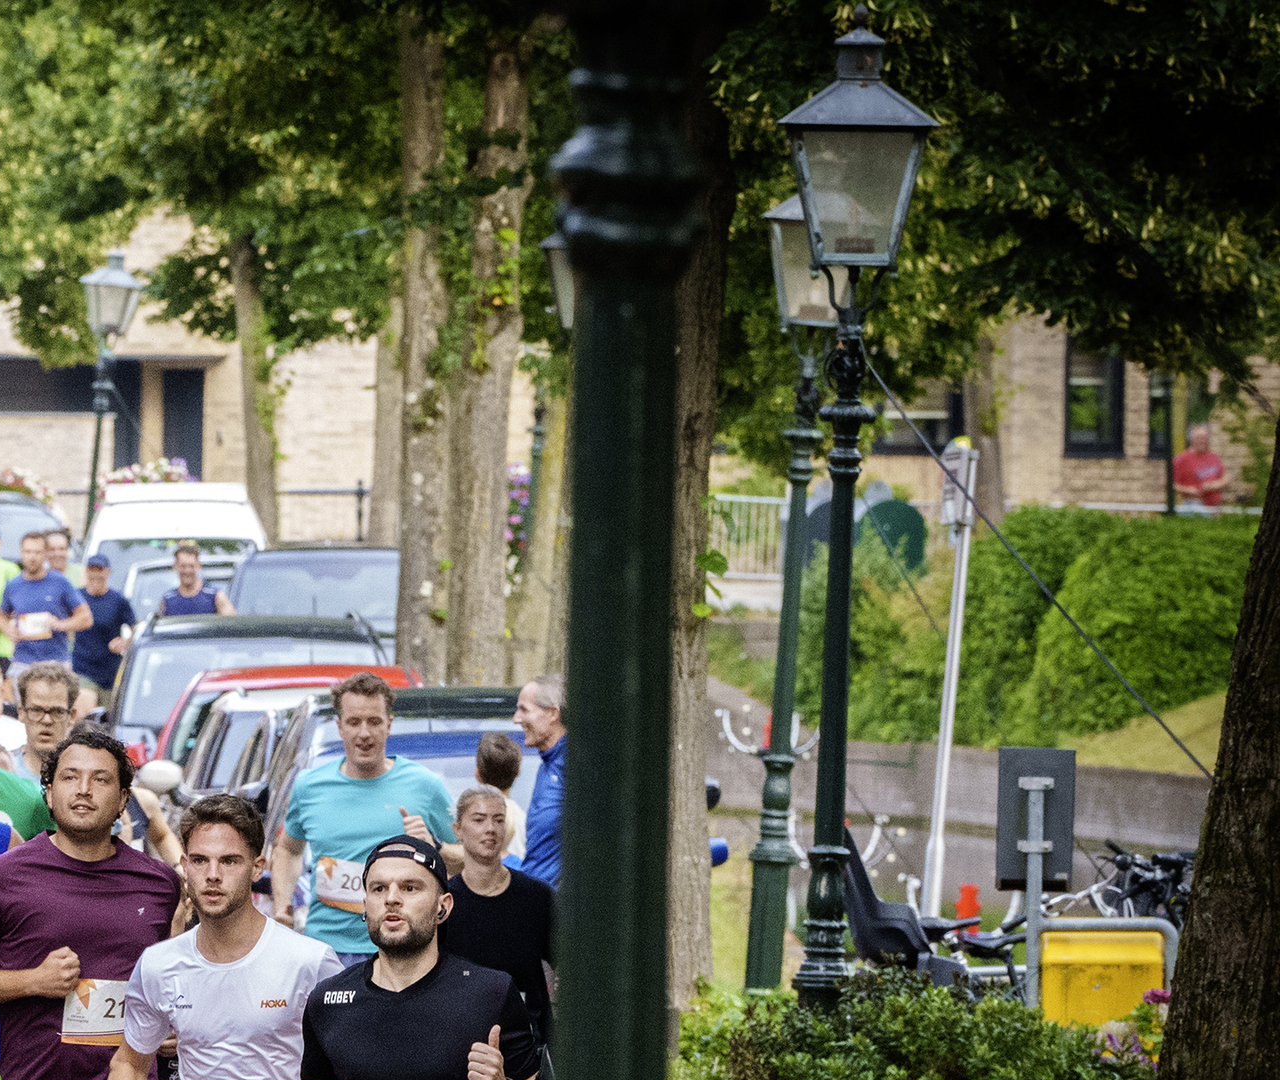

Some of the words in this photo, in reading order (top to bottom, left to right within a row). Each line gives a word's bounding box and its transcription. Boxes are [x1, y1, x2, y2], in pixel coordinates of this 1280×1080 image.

[341, 873, 361, 891] 20
[260, 999, 288, 1009] HOKA
[323, 990, 356, 1004] ROBEY
[103, 997, 126, 1019] 21
